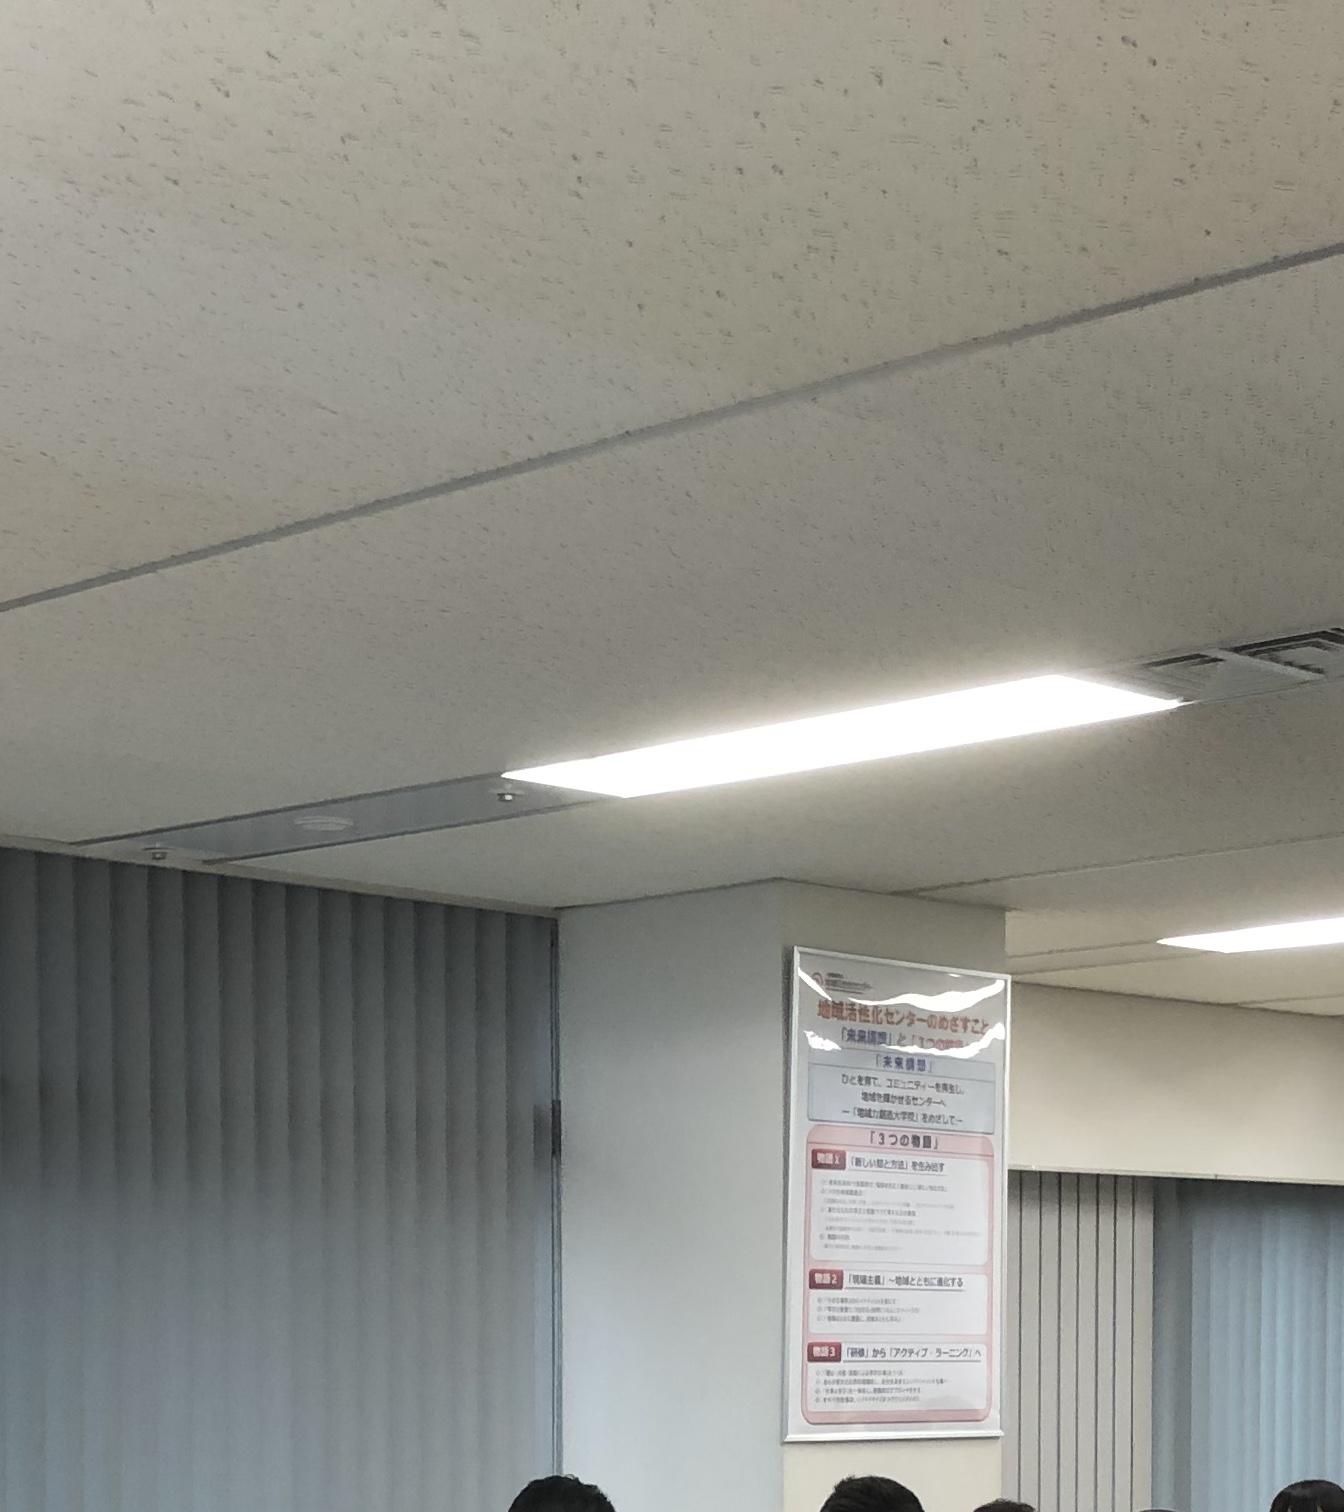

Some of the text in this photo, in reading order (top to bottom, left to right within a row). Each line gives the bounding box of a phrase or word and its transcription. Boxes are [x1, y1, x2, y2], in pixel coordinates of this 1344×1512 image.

[817, 1000, 990, 1034] 地域活性化センターのめざすこと
[876, 1054, 934, 1073] 「未来構想」
[869, 1131, 940, 1150] 「3つの物語」
